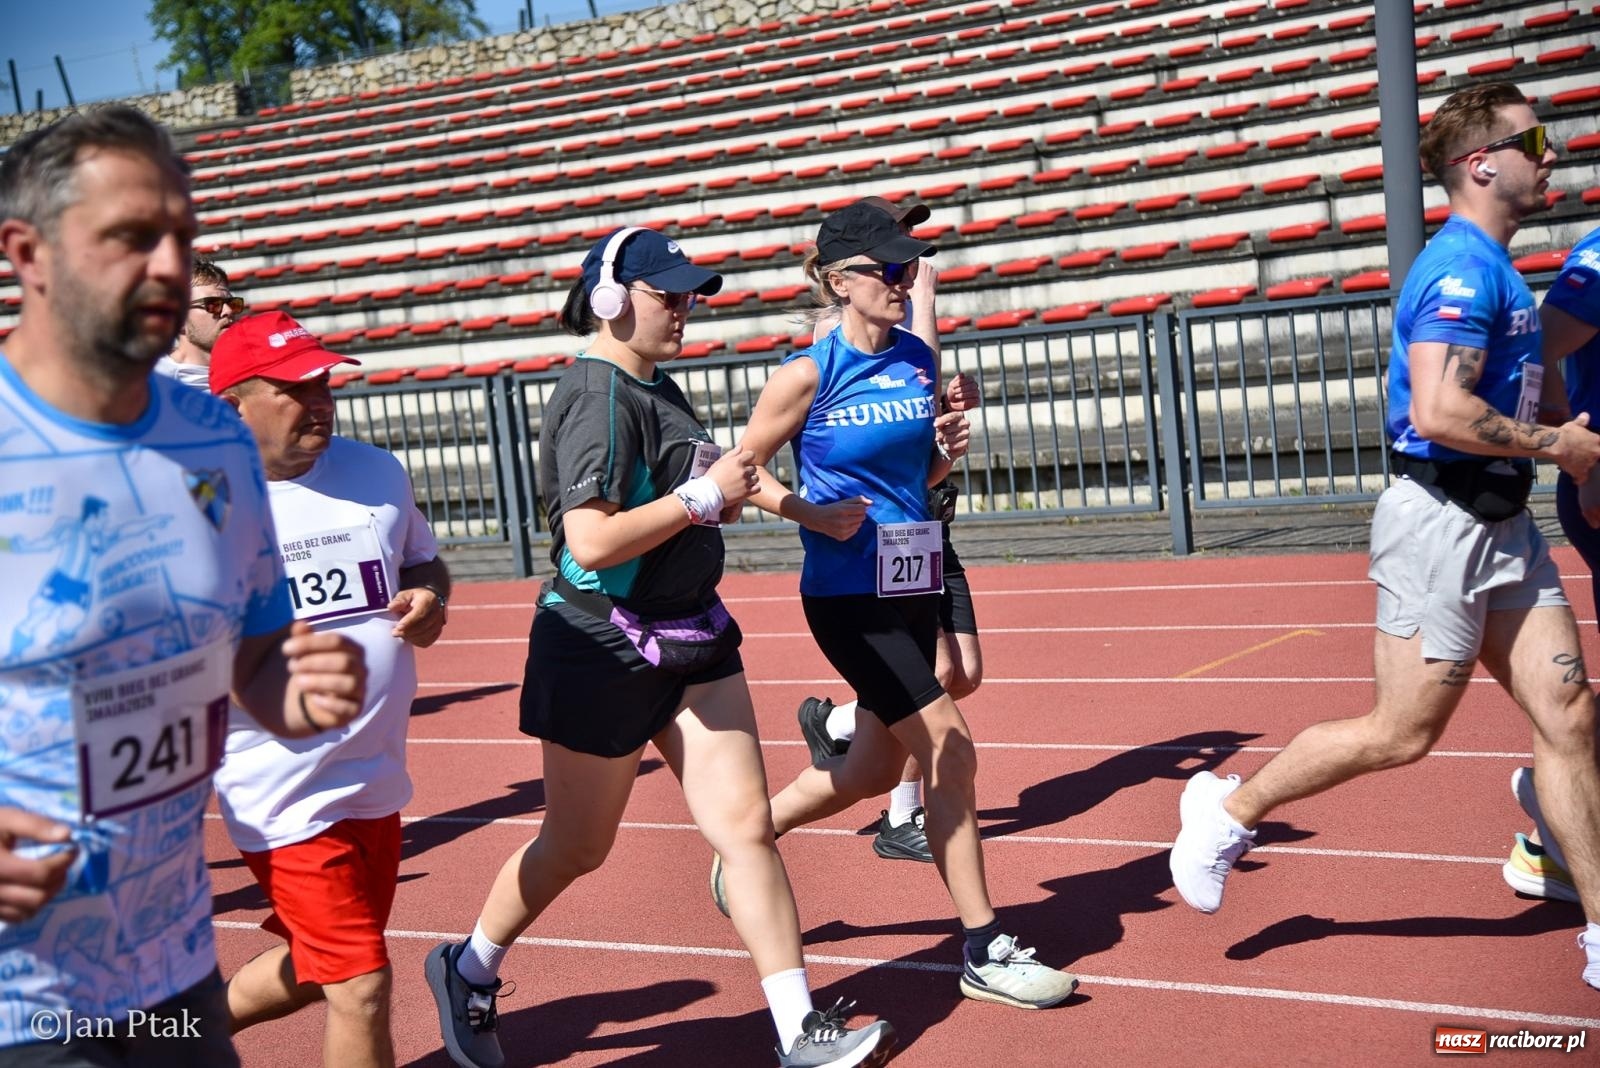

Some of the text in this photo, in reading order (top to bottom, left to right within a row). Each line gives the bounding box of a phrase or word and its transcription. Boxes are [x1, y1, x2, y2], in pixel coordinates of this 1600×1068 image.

[283, 533, 352, 553] BIEG BEZ GRANIC
[892, 555, 924, 583] 217
[287, 568, 353, 609] 132
[111, 717, 193, 791] 241
